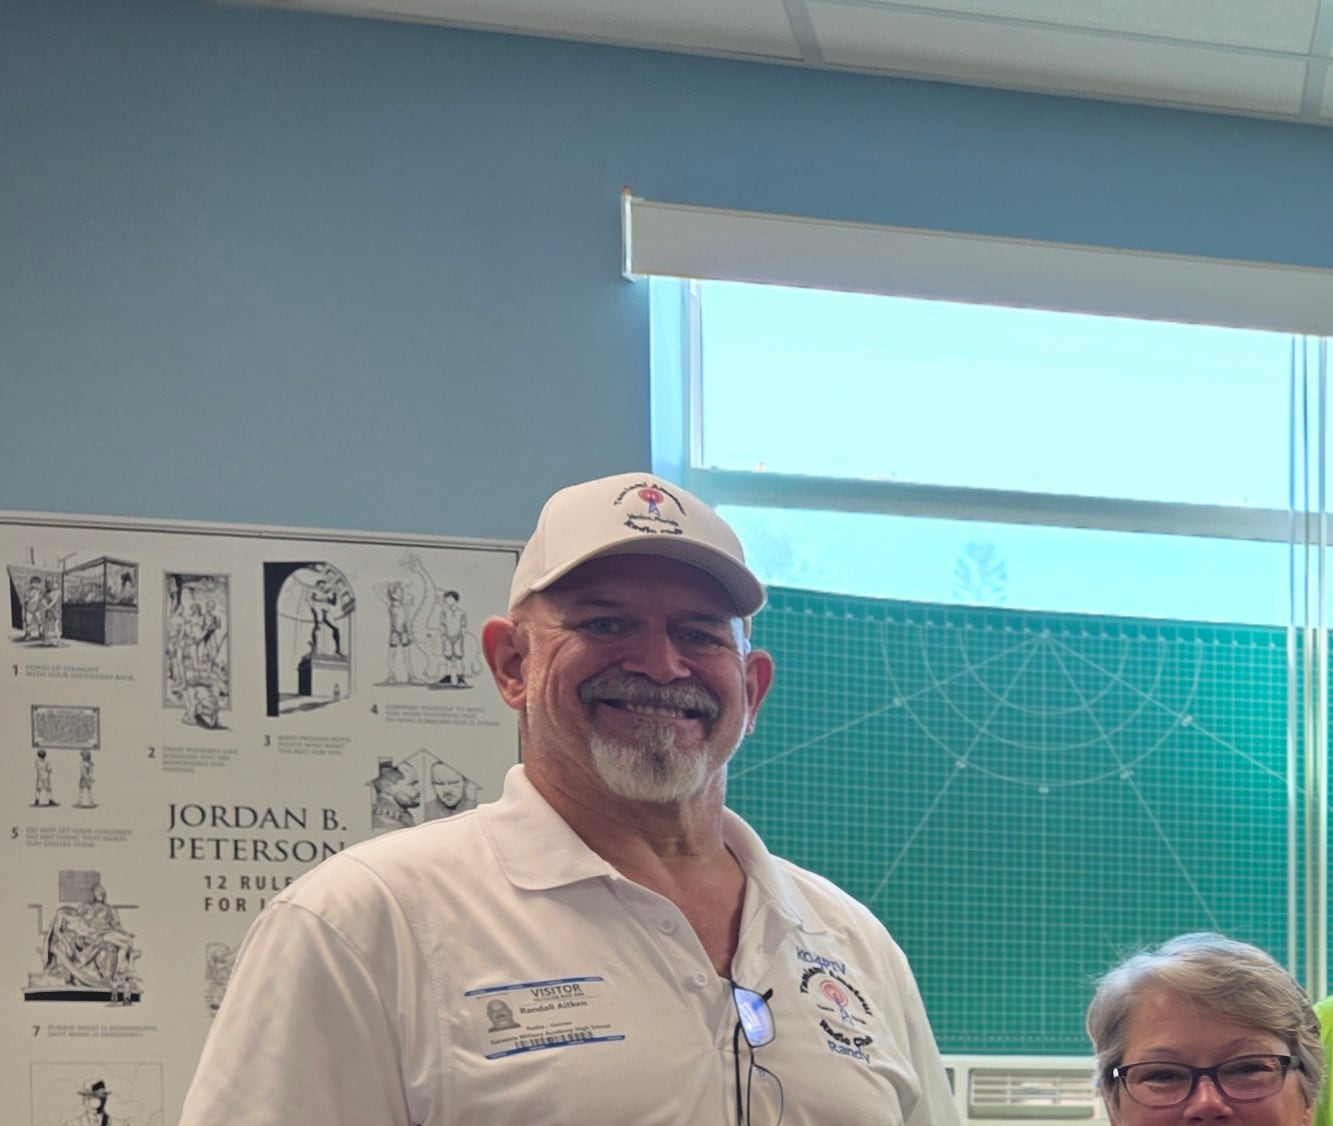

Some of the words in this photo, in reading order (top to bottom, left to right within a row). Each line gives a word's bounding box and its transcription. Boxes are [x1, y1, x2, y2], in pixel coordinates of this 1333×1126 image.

[12, 664, 18, 677] 1
[370, 704, 378, 715] 4
[263, 735, 271, 746] 3
[148, 747, 155, 758] 2
[167, 804, 307, 832] JORDAN
[322, 809, 348, 831] B.
[11, 827, 18, 839] 5
[168, 837, 346, 863] PETERSON
[204, 875, 228, 890] 12
[240, 876, 294, 891] RULE
[204, 897, 247, 912] FOR
[530, 983, 583, 998] VISITOR
[519, 1003, 556, 1015] Randall
[32, 1025, 40, 1037] 7
